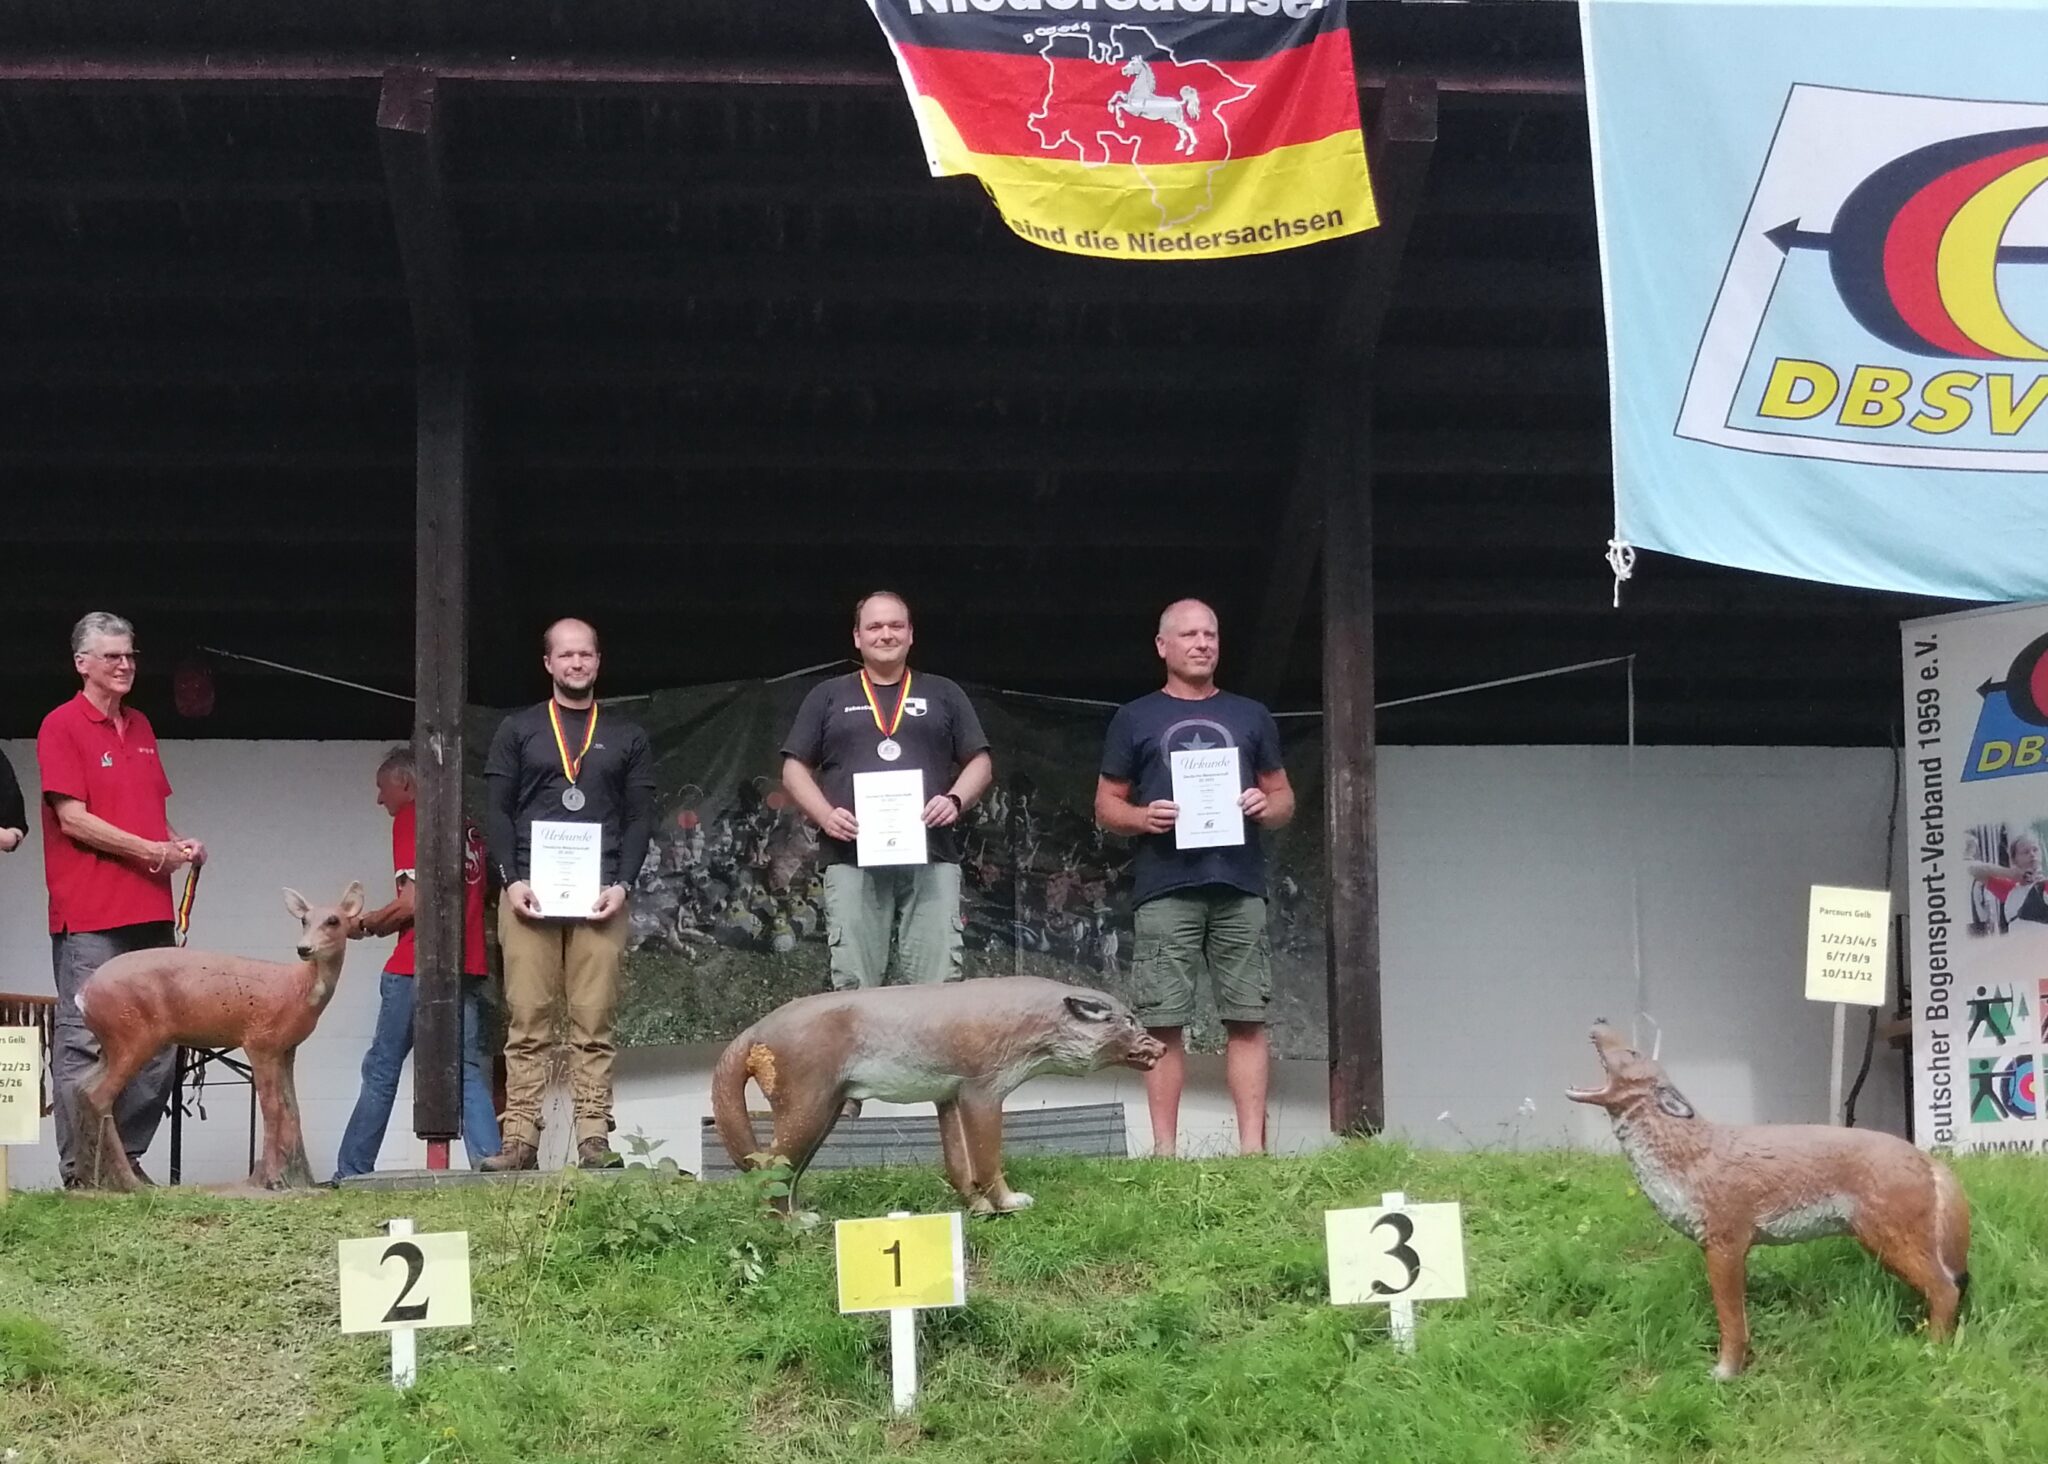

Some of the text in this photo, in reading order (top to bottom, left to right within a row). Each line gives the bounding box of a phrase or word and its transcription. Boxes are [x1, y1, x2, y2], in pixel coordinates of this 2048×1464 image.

[1011, 208, 1344, 253] sind die Niedersachsen
[1756, 357, 2048, 436] DBSV
[1916, 688, 1941, 750] 1959
[1976, 735, 2048, 773] DB
[1918, 757, 1954, 1021] Bogensport-Verband
[1819, 906, 1872, 919] Parcours Gelb
[1820, 933, 1877, 948] 1/2/3/4/5
[1826, 951, 1871, 964] 6/7/8/9
[1821, 968, 1873, 982] 10/11/12
[8, 1035, 26, 1044] Gelb
[883, 1240, 901, 1287] 1
[1370, 1212, 1421, 1295] 3
[380, 1241, 430, 1323] 2
